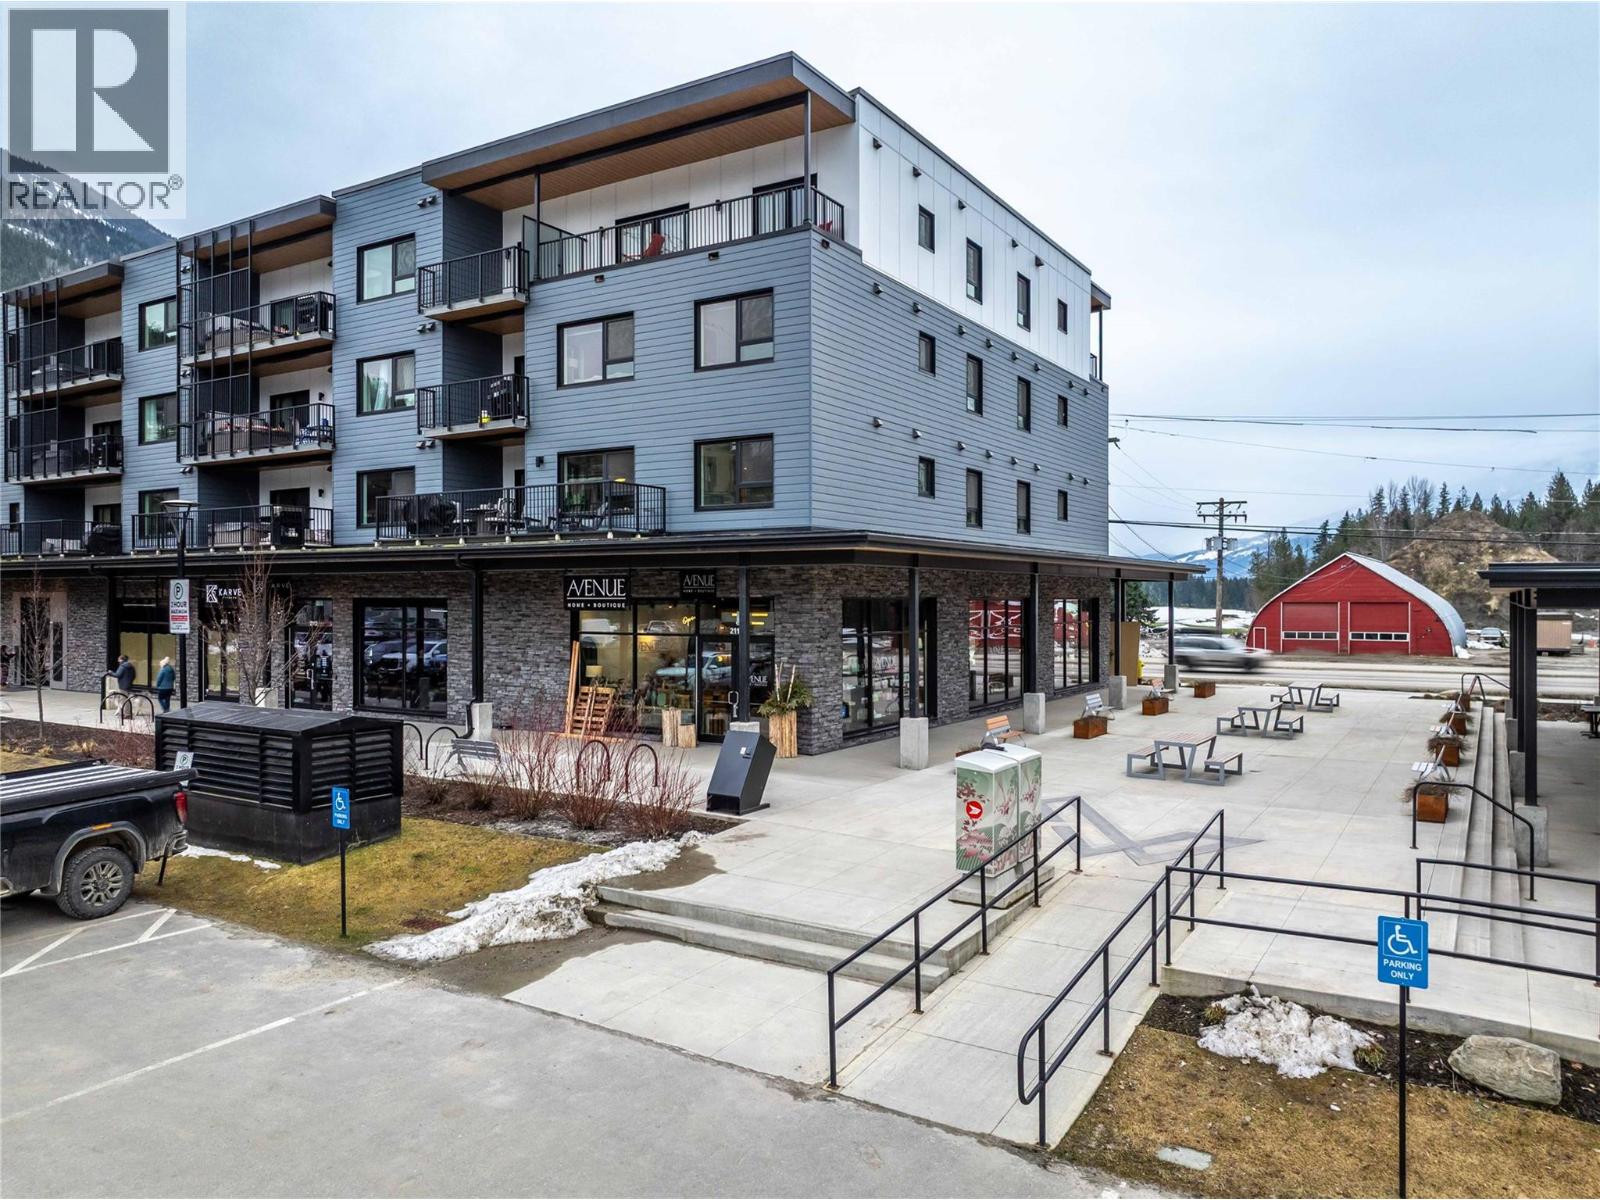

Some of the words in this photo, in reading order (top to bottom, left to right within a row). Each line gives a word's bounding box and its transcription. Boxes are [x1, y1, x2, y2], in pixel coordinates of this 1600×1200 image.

[683, 574, 715, 587] AVENUE
[218, 587, 242, 597] KARVE
[567, 578, 626, 597] AVENUE
[1383, 959, 1423, 972] PARKING
[1390, 969, 1415, 980] ONLY
